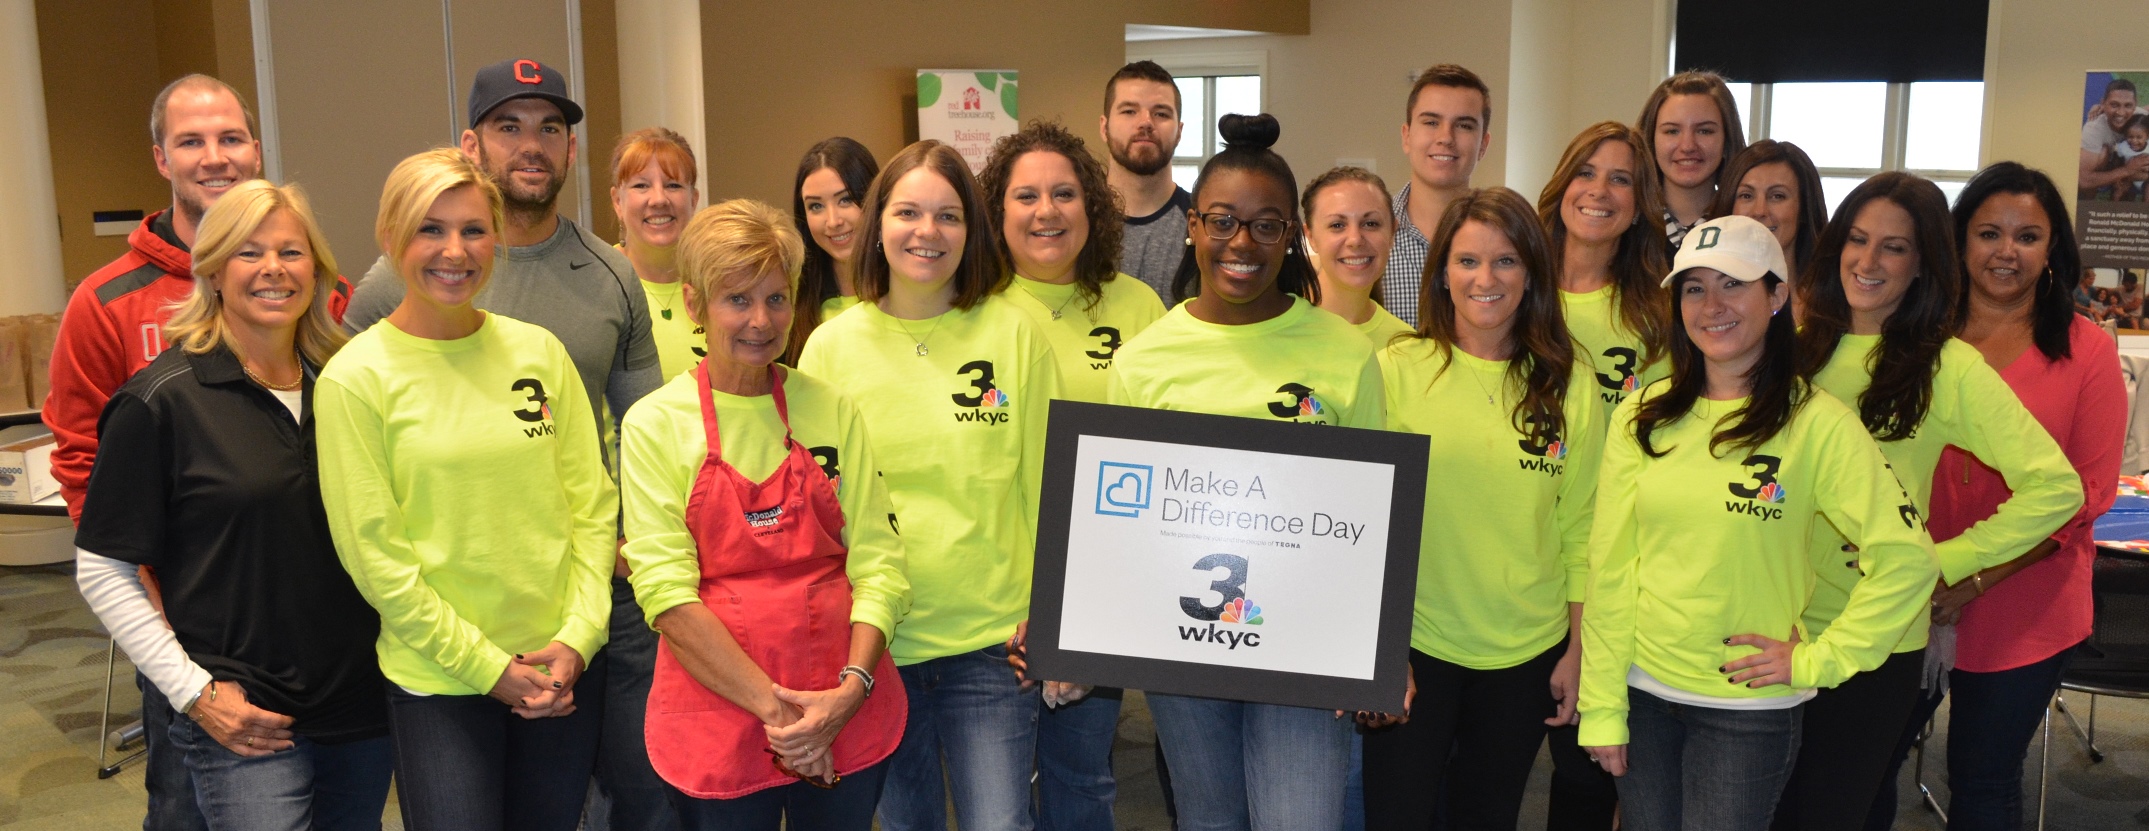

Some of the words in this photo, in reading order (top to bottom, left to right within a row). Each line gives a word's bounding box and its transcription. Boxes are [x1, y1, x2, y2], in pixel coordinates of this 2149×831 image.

[514, 59, 543, 84] C
[948, 110, 995, 120] treehouse.org
[954, 129, 991, 142] Raising
[954, 143, 983, 158] amily
[1696, 226, 1721, 250] D
[1085, 326, 1123, 360] 3
[1595, 347, 1637, 391] 3
[952, 359, 997, 408] 3
[511, 378, 548, 422] 3
[954, 409, 1009, 426] wkyc
[1519, 457, 1563, 477] wkyc
[1728, 454, 1783, 499] 3
[1164, 467, 1239, 497] Make
[1245, 475, 1267, 500] A
[1161, 498, 1304, 535] Difference
[1311, 512, 1366, 545] Day
[1725, 500, 1783, 522] wkyc
[753, 528, 784, 538] CLEVELAND
[1160, 530, 1177, 538] Made
[1246, 539, 1267, 547] people
[1275, 541, 1301, 549] TEGNA
[1179, 553, 1250, 621] 3
[1178, 623, 1261, 650] wkyc
